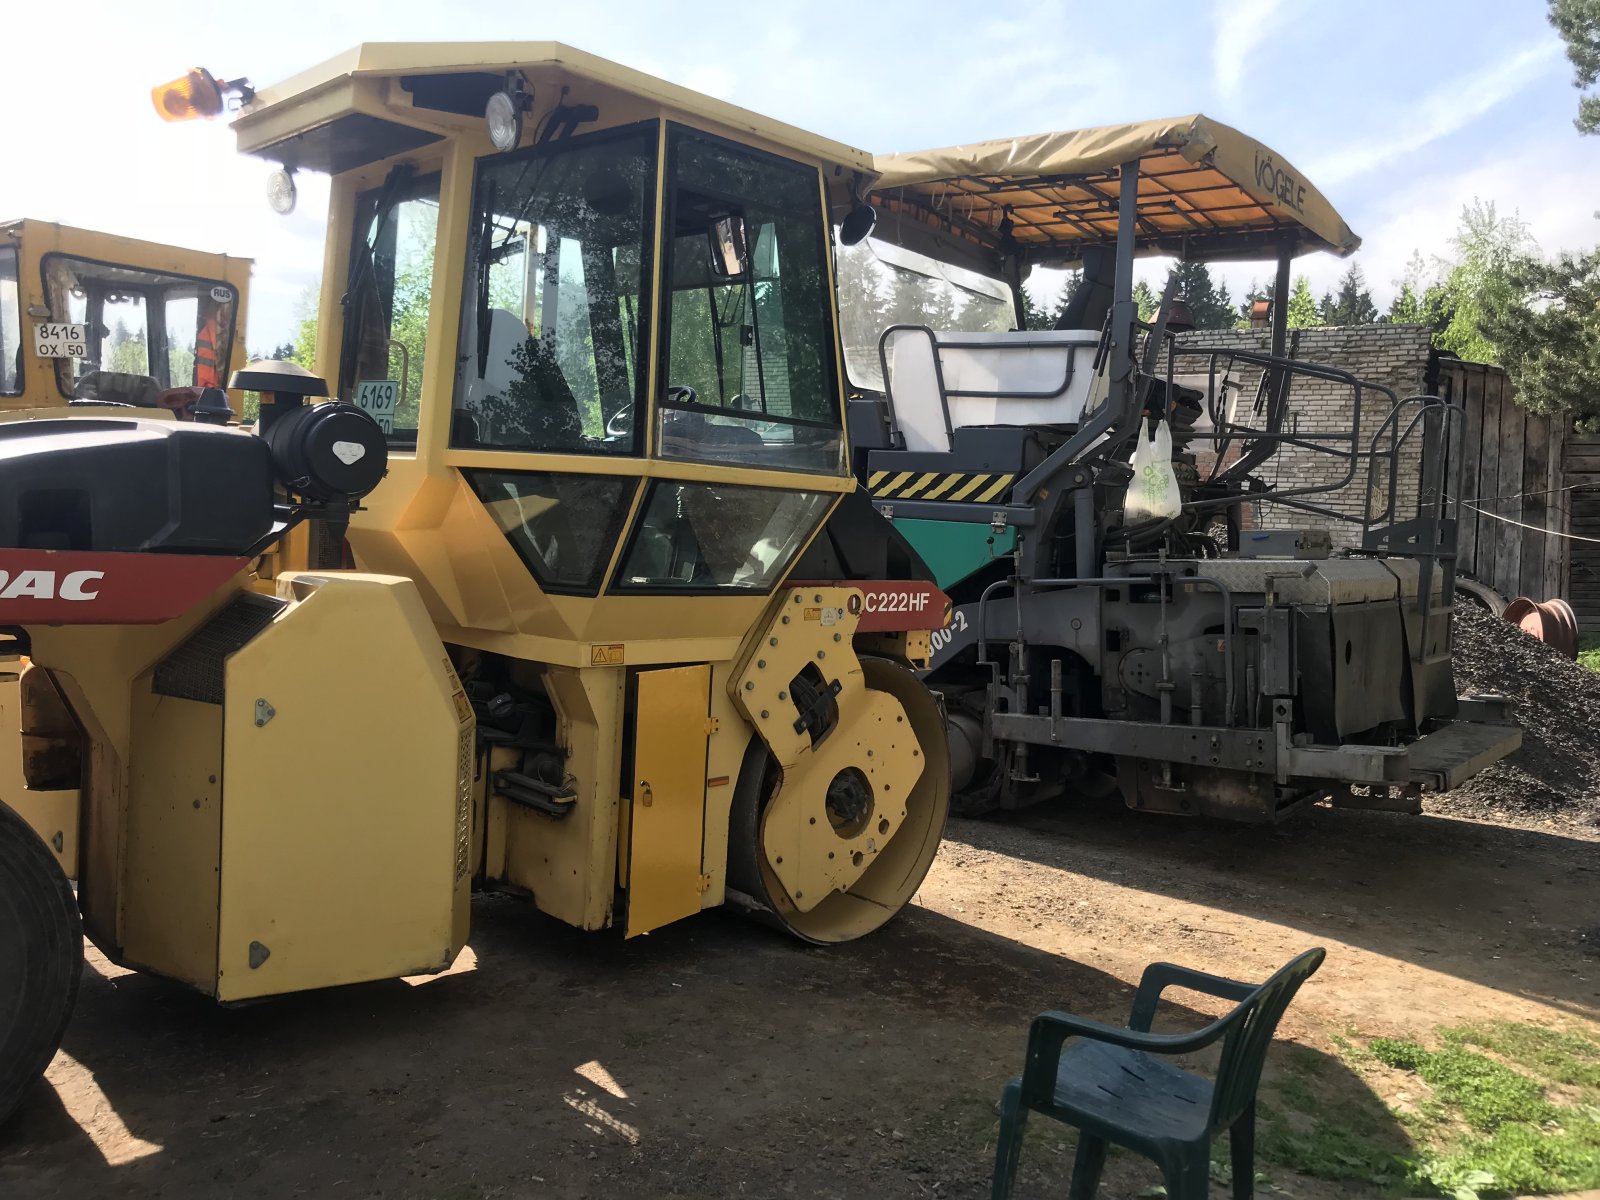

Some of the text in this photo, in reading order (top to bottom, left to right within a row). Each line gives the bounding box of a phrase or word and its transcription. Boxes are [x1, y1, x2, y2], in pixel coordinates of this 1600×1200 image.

[1255, 150, 1306, 216] VÖGELE
[213, 288, 231, 299] RUS
[40, 325, 80, 340] 8416
[67, 344, 84, 356] 50
[360, 385, 393, 409] 6169
[853, 592, 930, 613] C222HF
